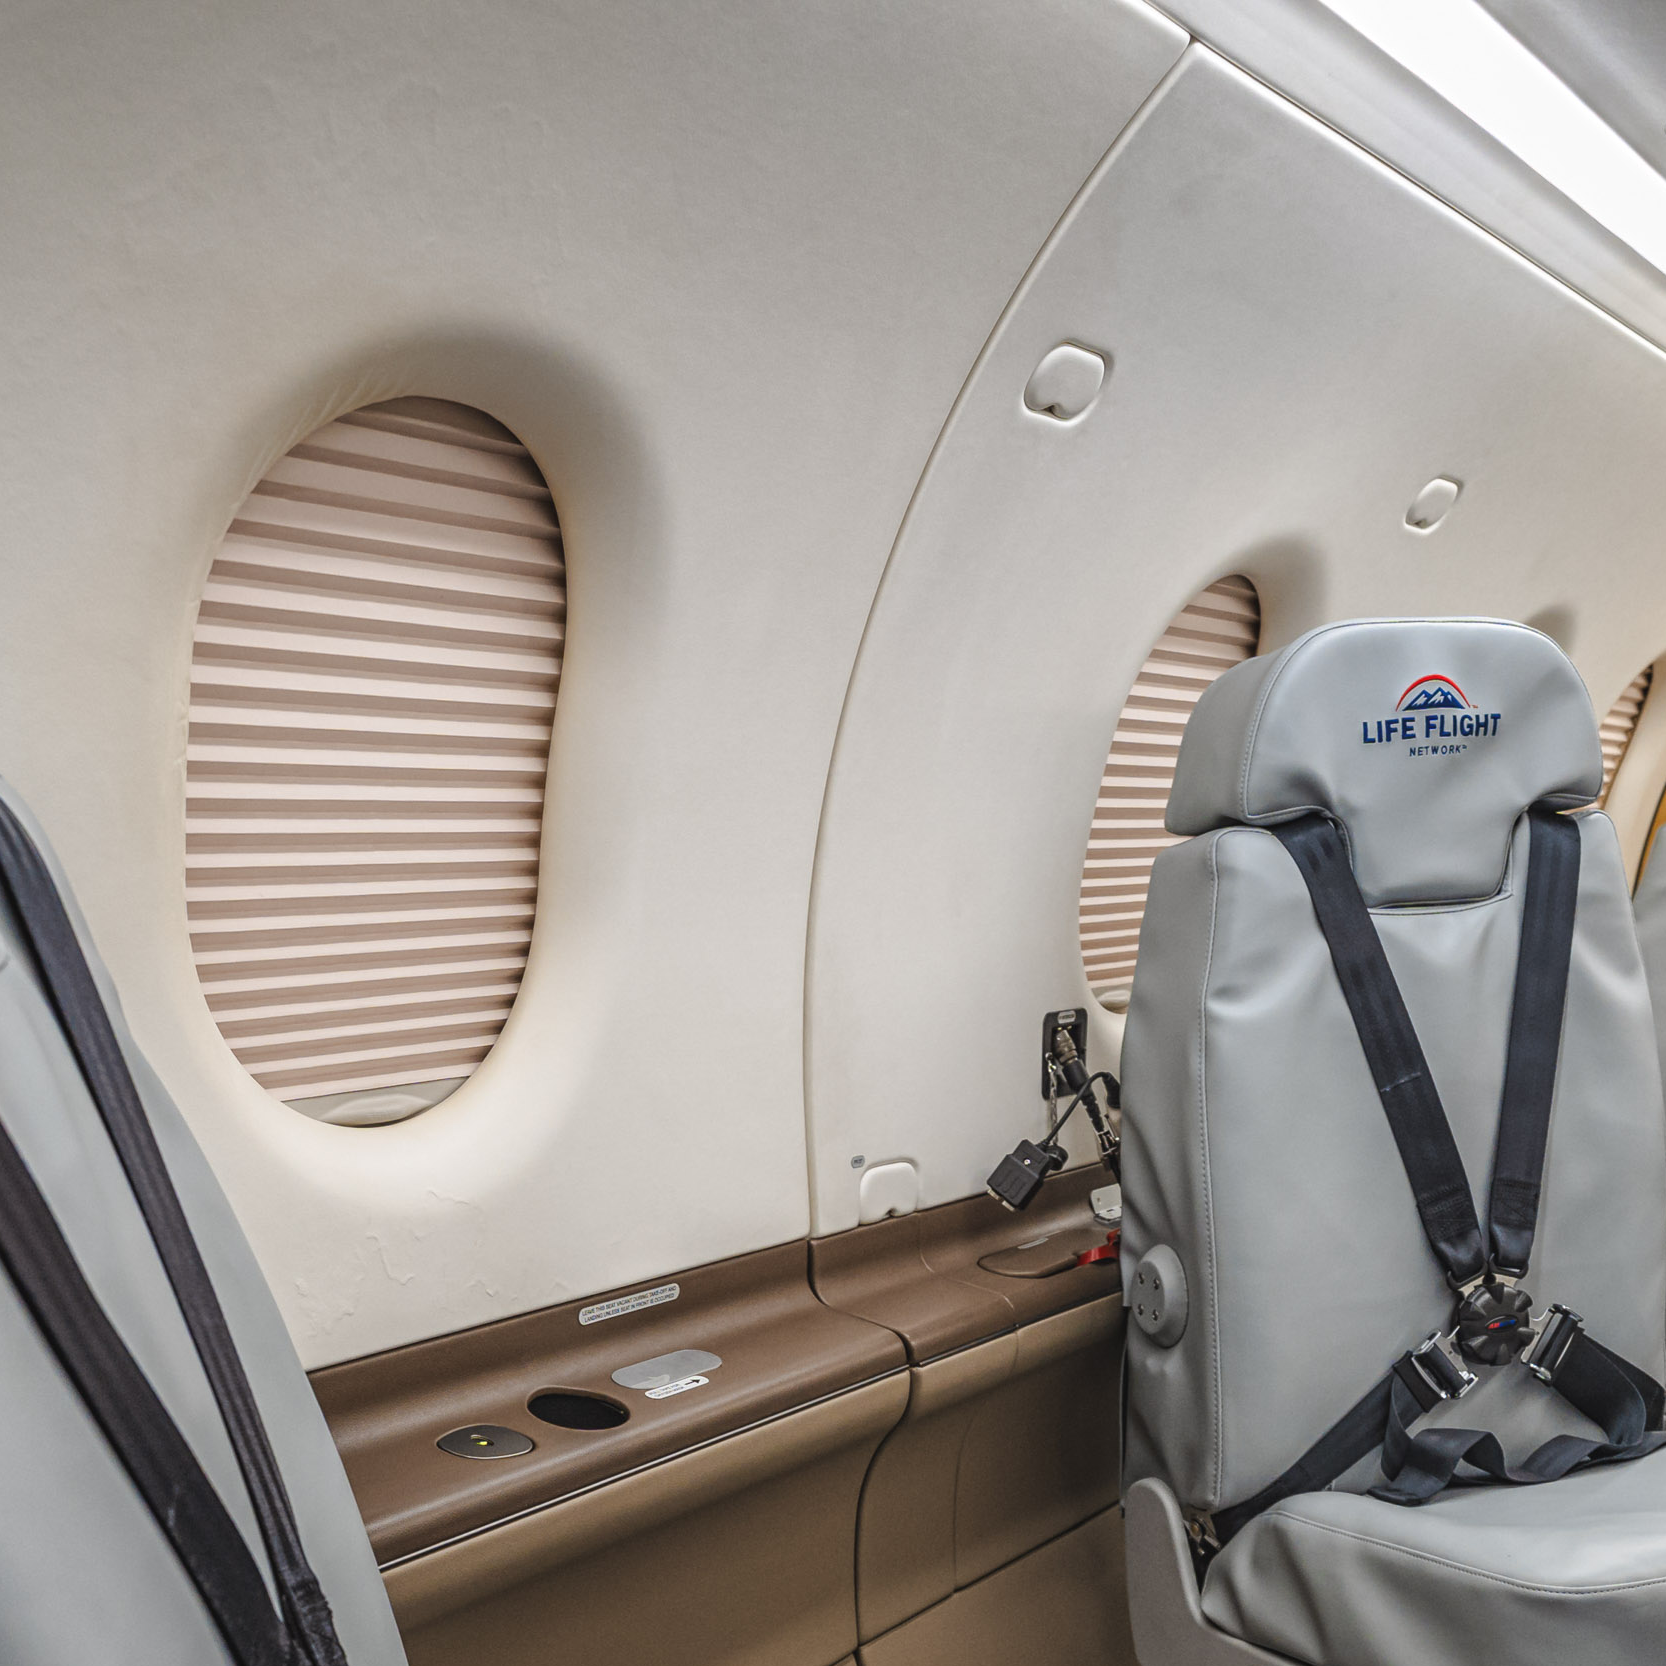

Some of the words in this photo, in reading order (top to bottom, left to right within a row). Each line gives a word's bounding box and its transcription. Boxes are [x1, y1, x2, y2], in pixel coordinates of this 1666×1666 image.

[1362, 716, 1416, 744] LIFE
[1424, 713, 1501, 739] FLIGHT
[1409, 745, 1462, 757] NETWORK
